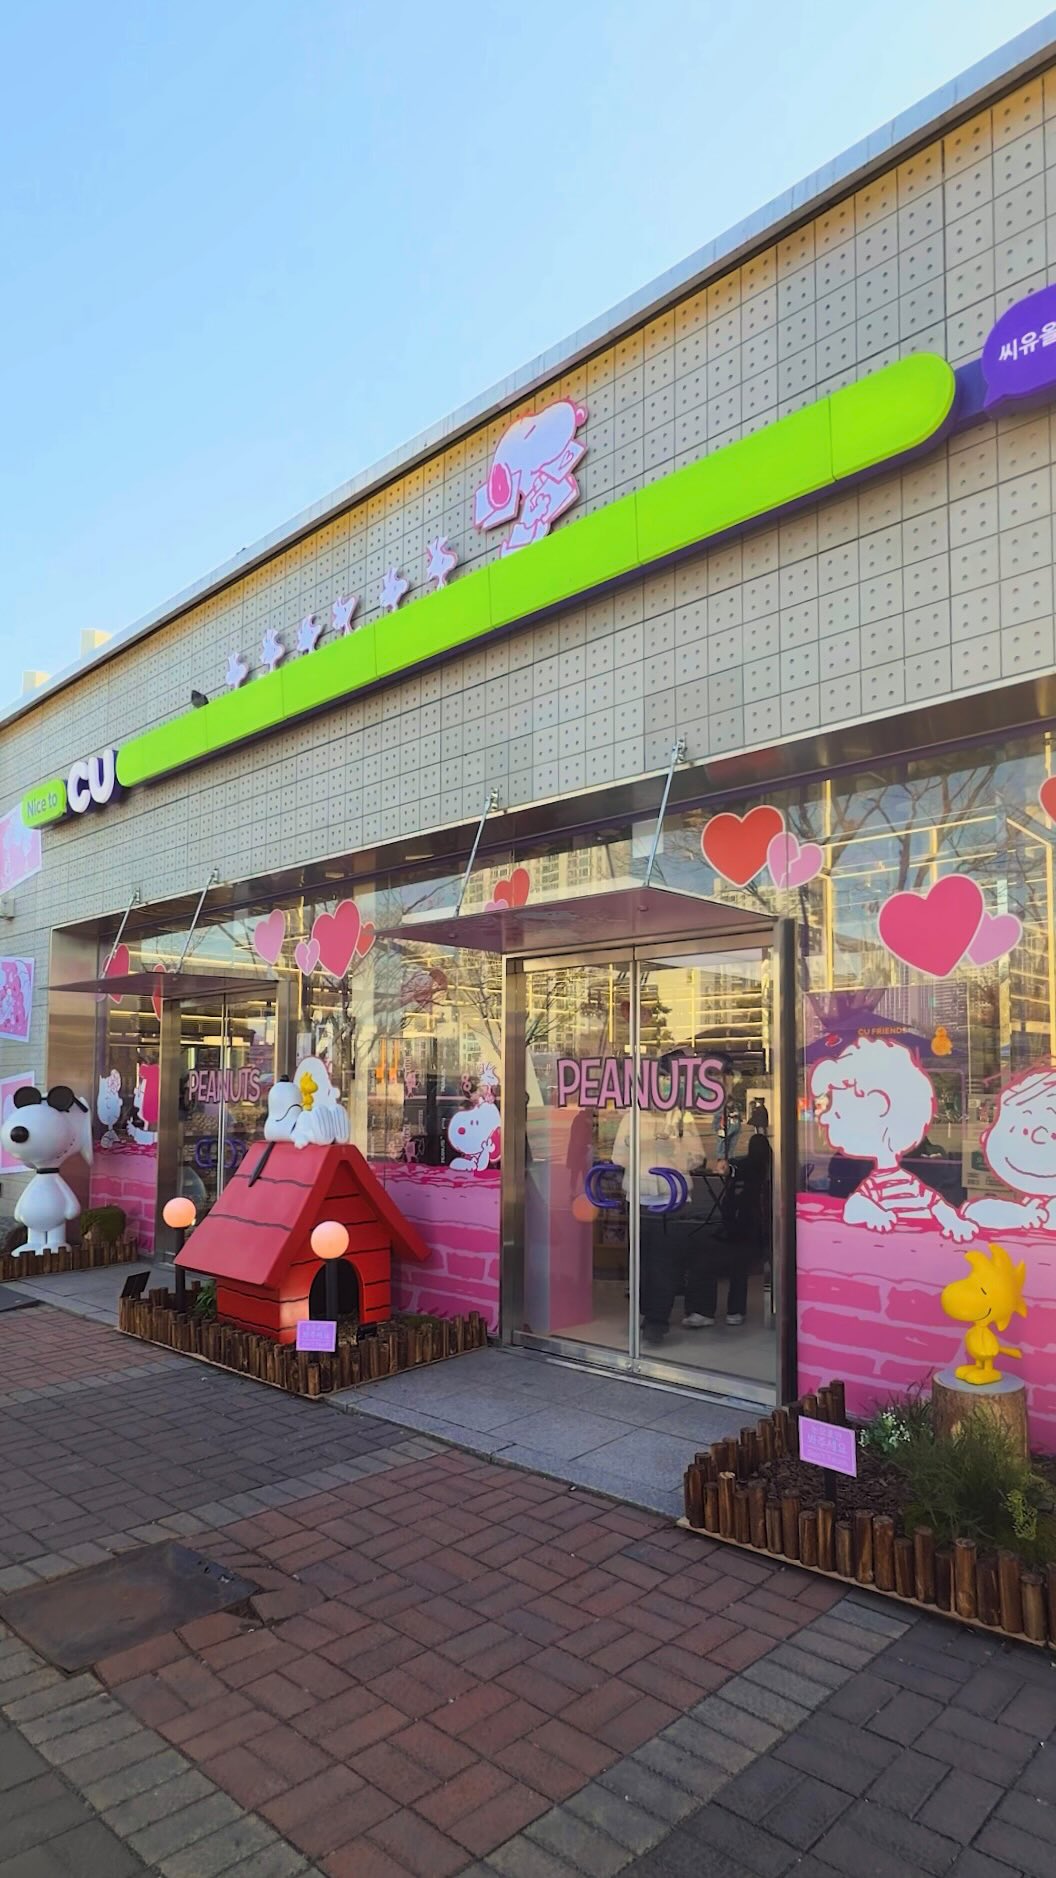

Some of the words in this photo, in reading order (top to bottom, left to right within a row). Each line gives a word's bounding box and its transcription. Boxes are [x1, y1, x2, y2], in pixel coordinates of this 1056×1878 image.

[26, 797, 47, 818] Nice
[48, 792, 58, 809] to
[67, 750, 115, 813] CU
[188, 1067, 261, 1103] PEANUTS
[557, 1056, 725, 1111] PEANUTS
